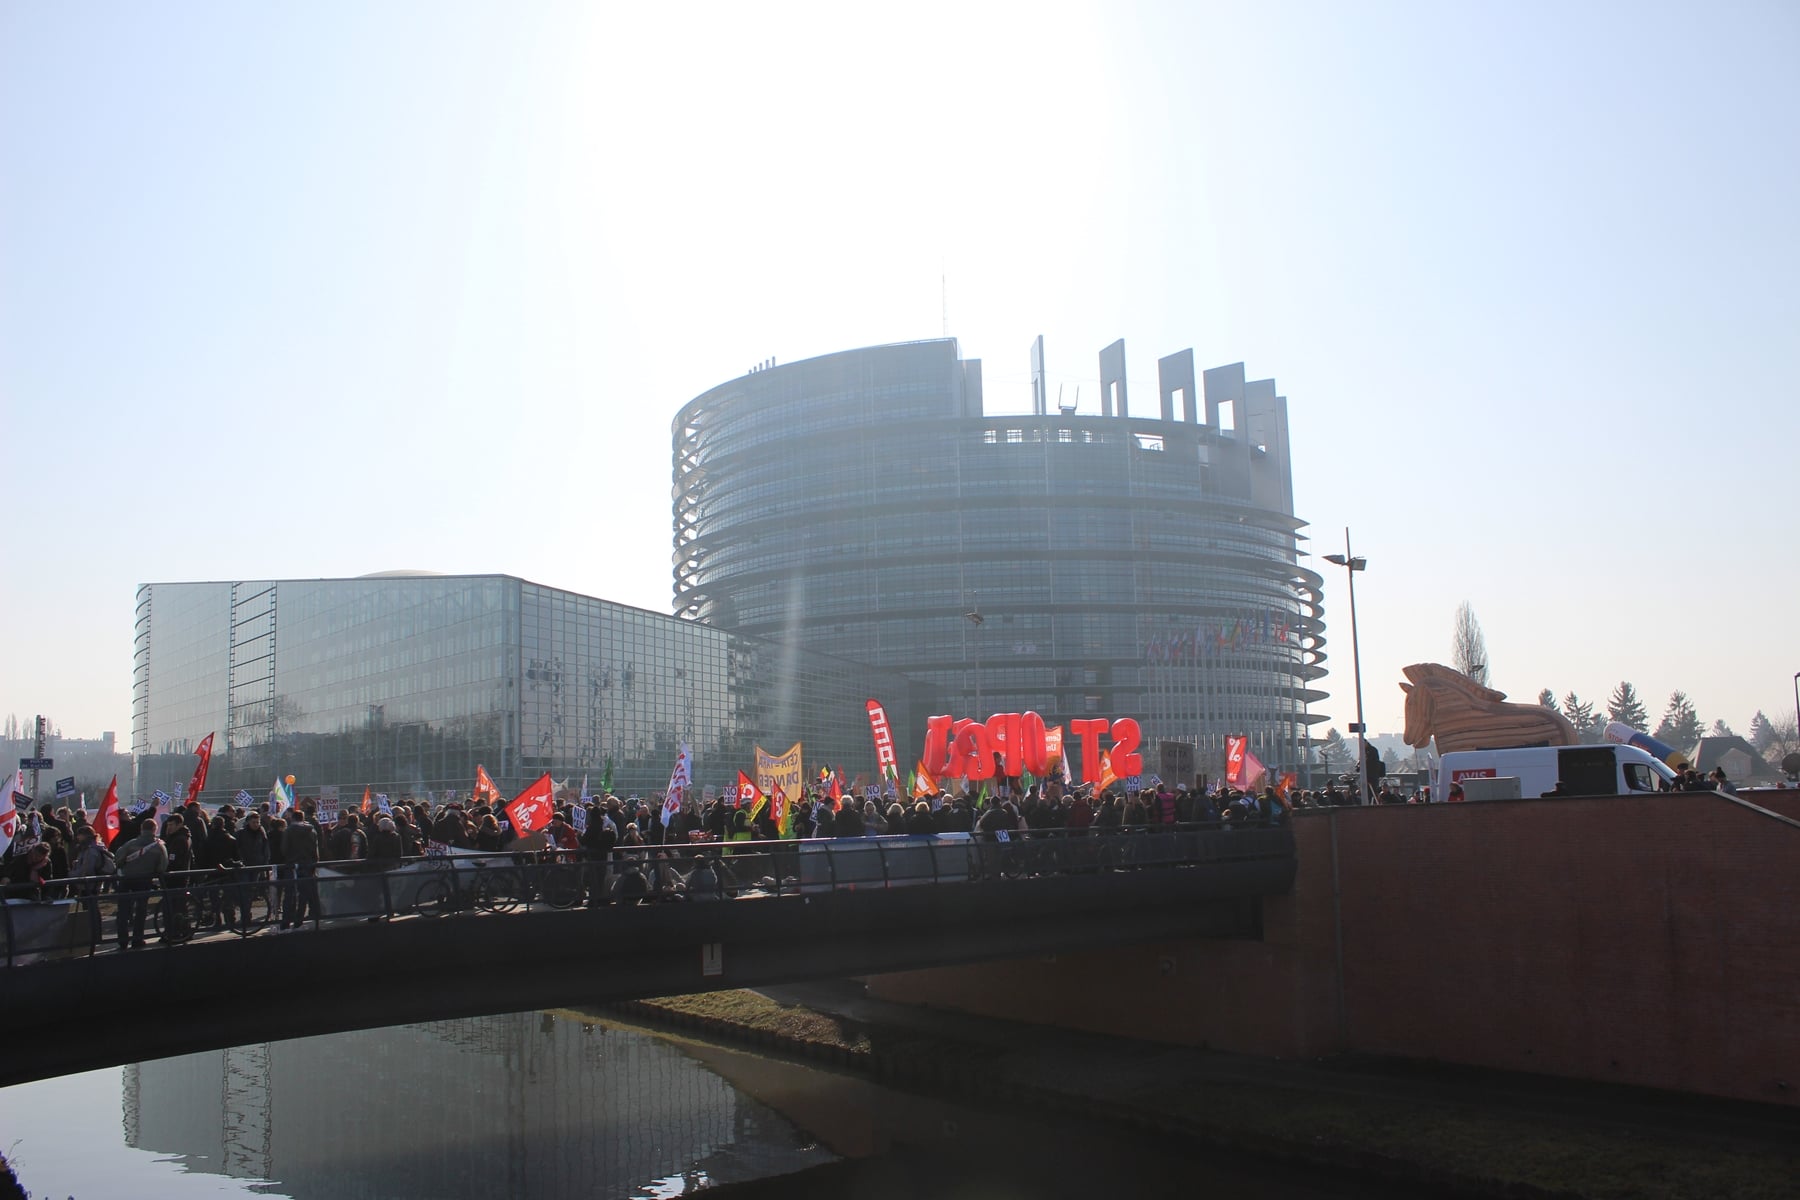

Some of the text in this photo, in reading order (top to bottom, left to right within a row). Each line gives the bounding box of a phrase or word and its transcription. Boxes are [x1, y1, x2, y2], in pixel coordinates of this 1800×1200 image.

[1457, 771, 1488, 783] AVIS
[235, 790, 246, 801] NO
[724, 787, 737, 796] NO
[866, 786, 880, 795] NO
[513, 802, 533, 828] NPA
[574, 807, 585, 820] NO
[996, 830, 1008, 840] NO
